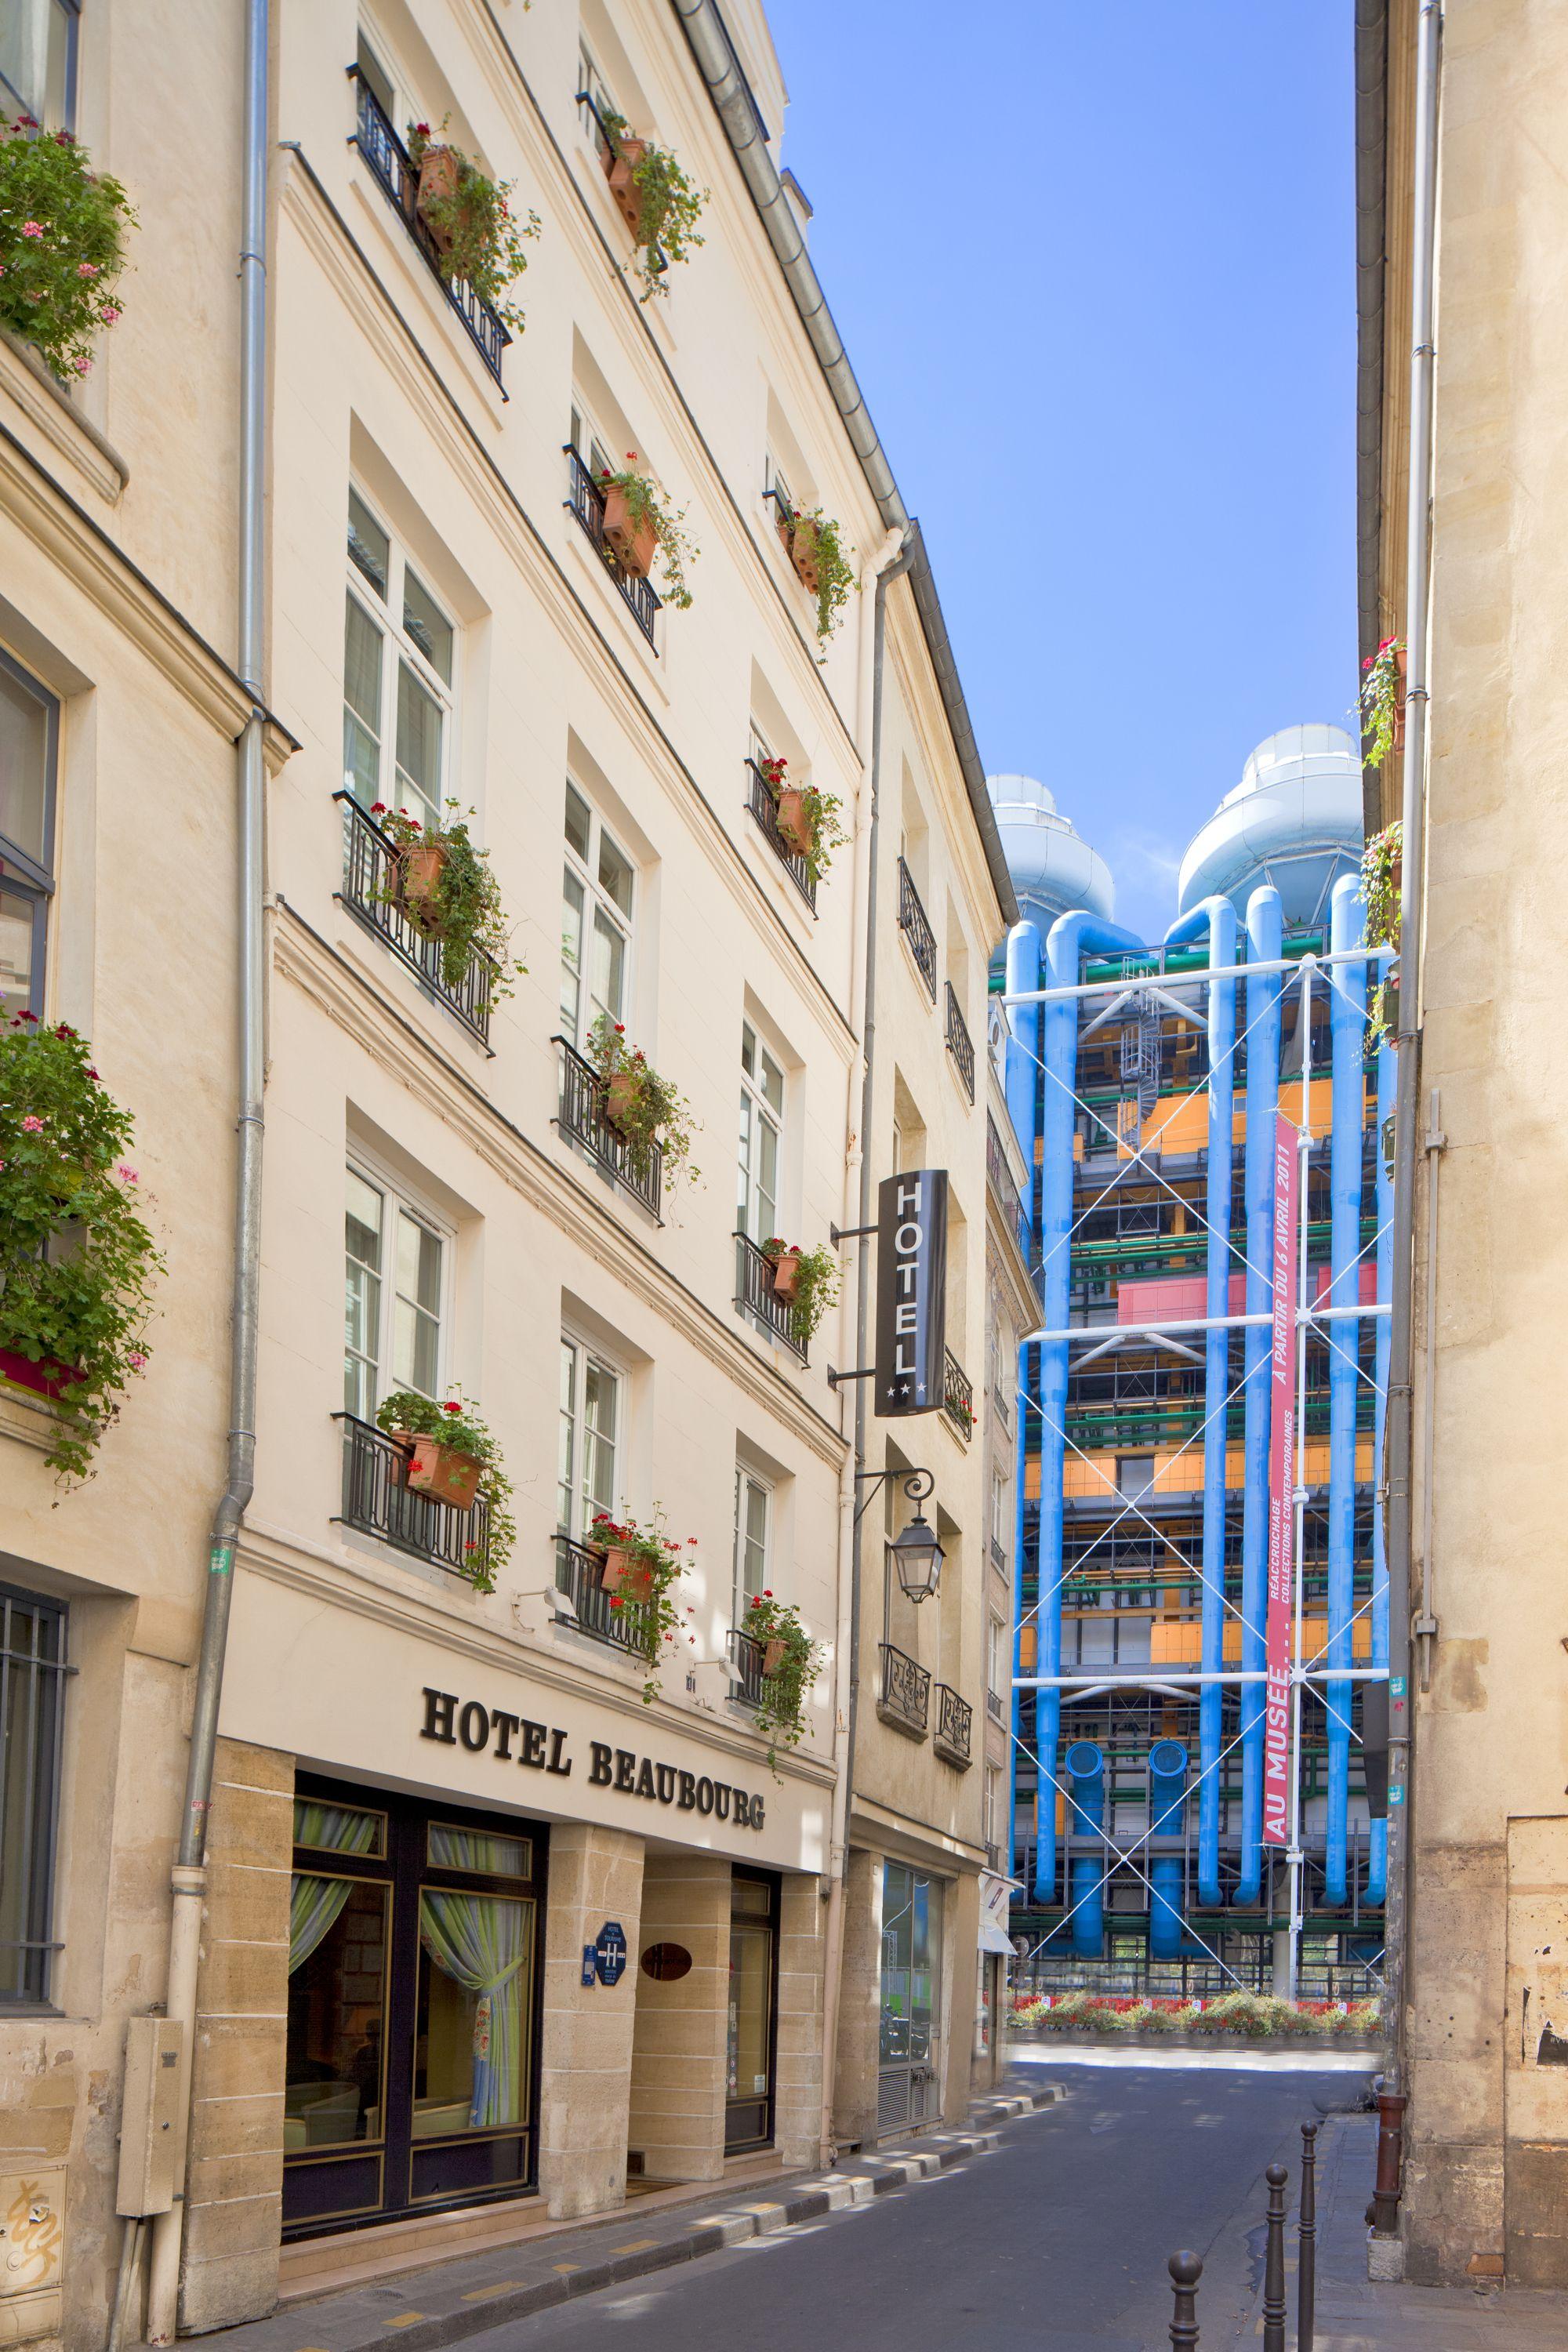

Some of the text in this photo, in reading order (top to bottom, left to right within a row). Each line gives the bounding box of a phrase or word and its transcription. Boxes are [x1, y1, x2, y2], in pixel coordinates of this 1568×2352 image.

[895, 1182, 924, 1375] HOTEL
[1272, 1143, 1290, 1385] À PARTIR DU 6 AVRIL 2011
[1269, 1497, 1281, 1600] RÉACCROCHAGE
[1280, 1410, 1293, 1605] COLLECTIONS CONTEMPORAINES
[421, 1686, 766, 1831] HOTEL BEAUBOURG
[1266, 1793, 1287, 1839] AU
[606, 1943, 617, 1966] H
